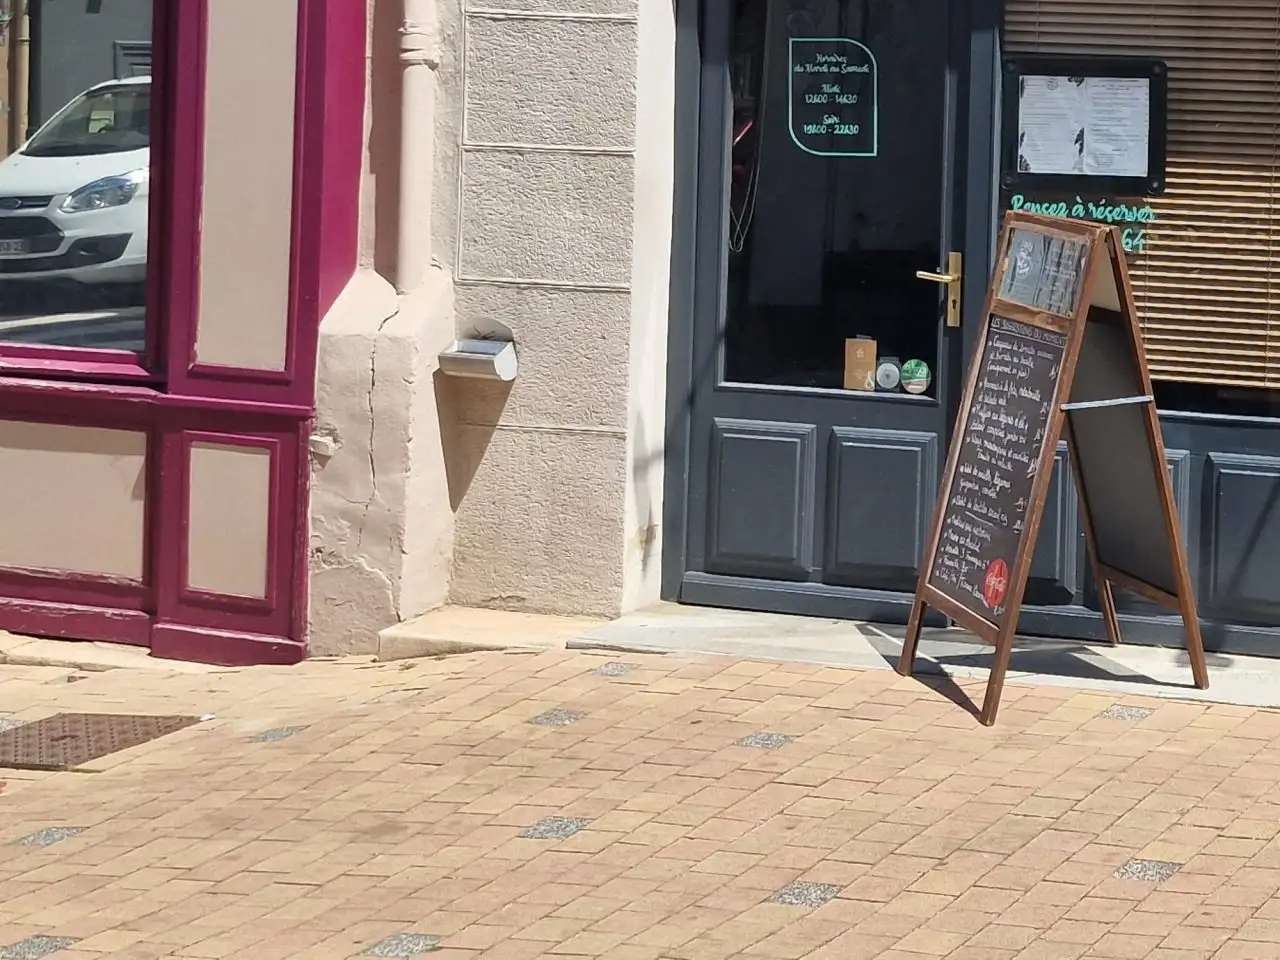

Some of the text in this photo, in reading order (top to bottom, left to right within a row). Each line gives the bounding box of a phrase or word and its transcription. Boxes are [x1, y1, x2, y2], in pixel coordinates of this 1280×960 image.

[1011, 194, 1155, 223] Pensez à réserver
